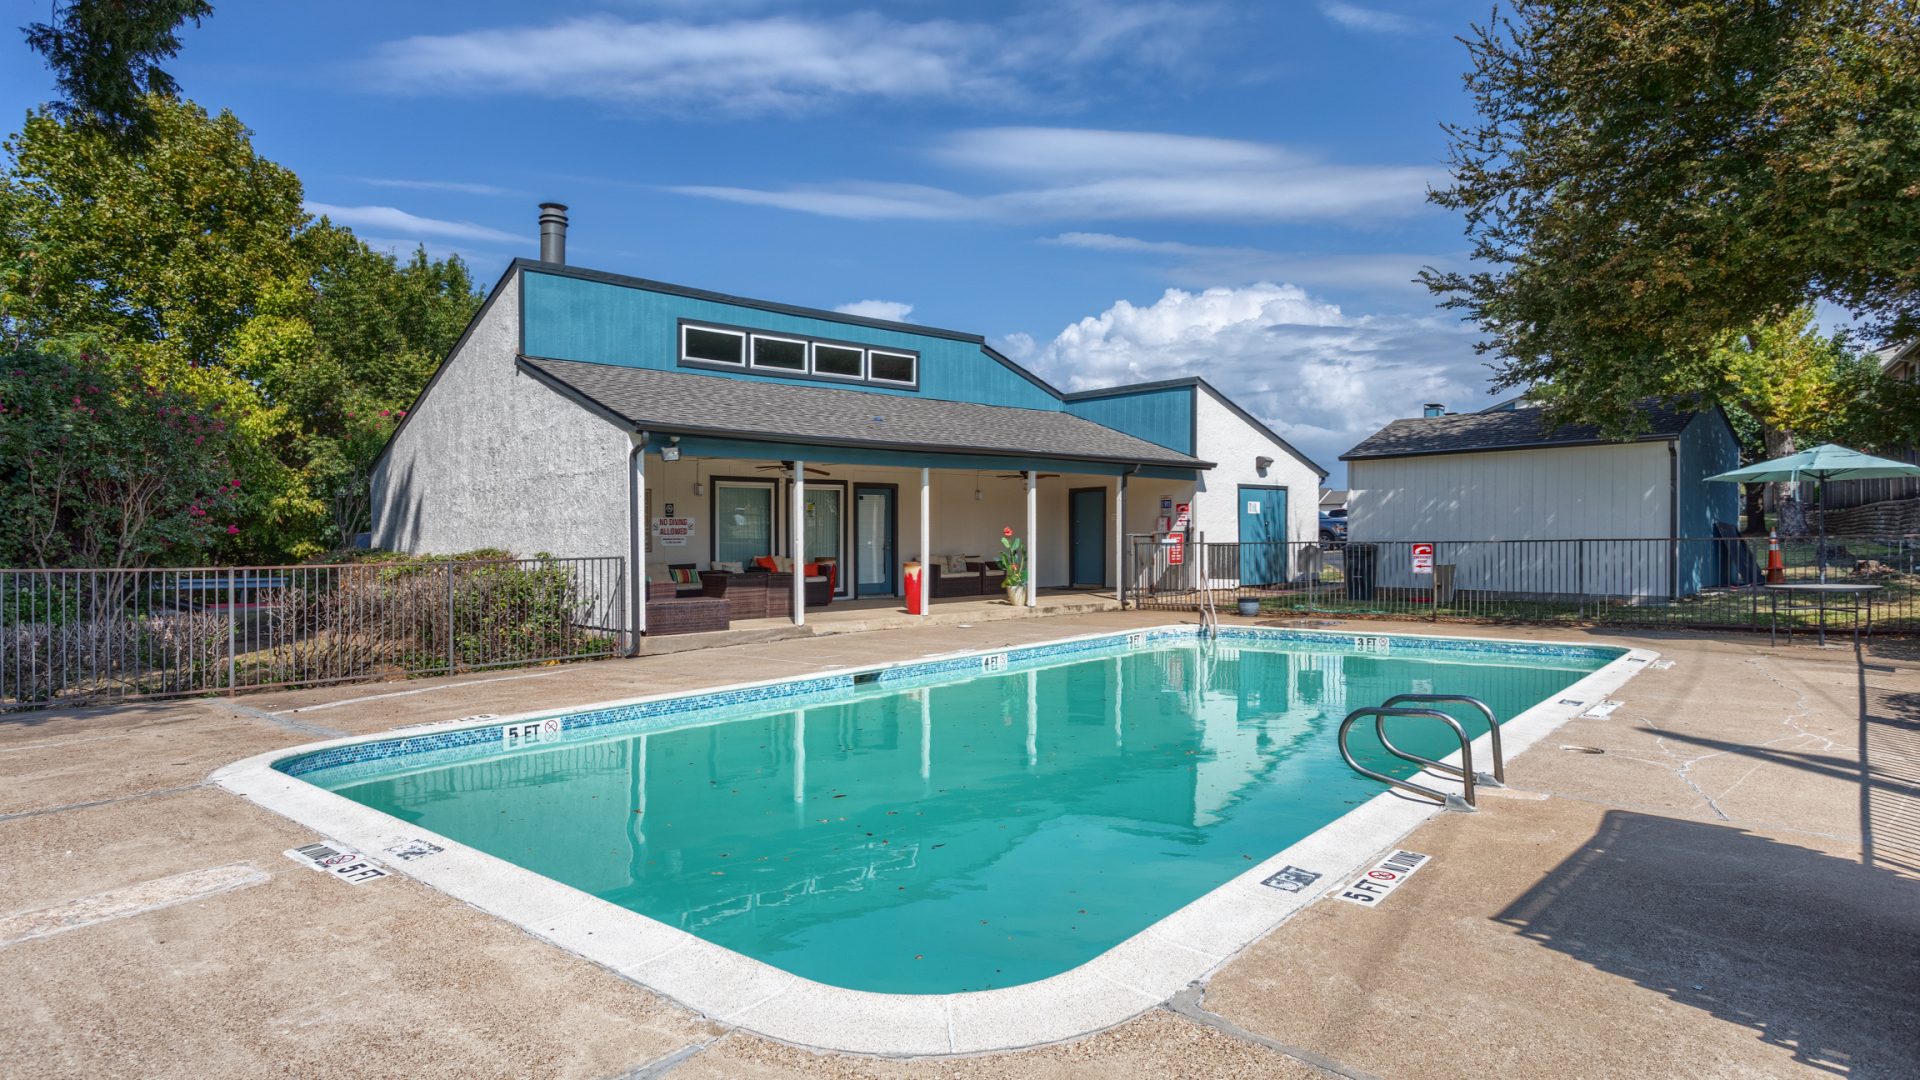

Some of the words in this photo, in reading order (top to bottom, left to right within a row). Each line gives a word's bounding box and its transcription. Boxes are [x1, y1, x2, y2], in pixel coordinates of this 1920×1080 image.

[659, 518, 668, 526] NO
[669, 518, 688, 526] DIVING
[660, 527, 688, 535] ALLOWED
[1357, 637, 1364, 646] 3
[1366, 637, 1376, 646] FT
[984, 657, 990, 665] 4
[990, 656, 998, 665] FT
[508, 727, 518, 738] 5
[524, 724, 540, 736] FT
[337, 863, 368, 874] 5
[347, 869, 386, 882] FT
[1354, 879, 1390, 894] FT
[1342, 891, 1375, 902] 5
